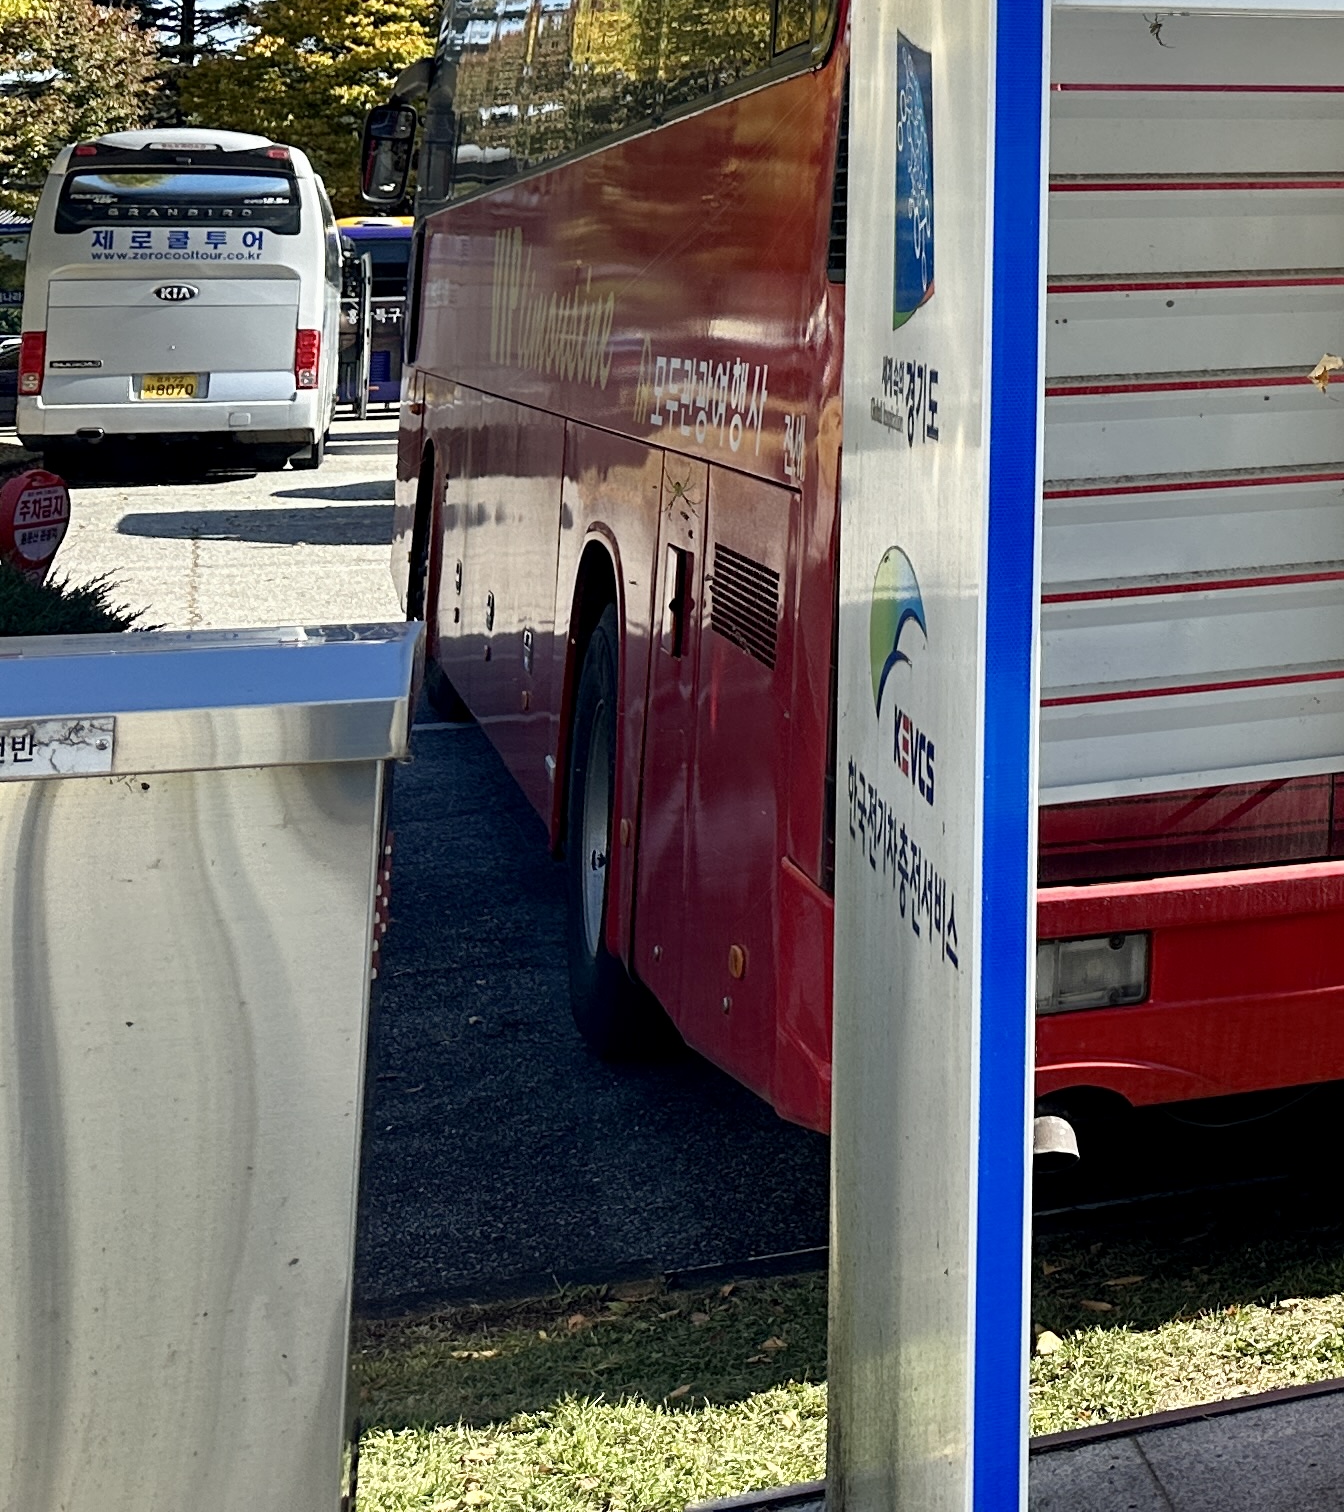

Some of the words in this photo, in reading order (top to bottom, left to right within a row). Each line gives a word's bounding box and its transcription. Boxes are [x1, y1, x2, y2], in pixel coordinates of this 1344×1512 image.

[91, 229, 265, 251] 제로쿨투어
[91, 251, 263, 261] www.zerocooltour.co.kr
[160, 287, 191, 300] KIA
[651, 356, 768, 457] 모두관광여행사
[905, 359, 939, 449] 경기도
[19, 494, 64, 522] 주차금지
[894, 703, 935, 807] KEVCS
[848, 753, 960, 970] 한국전기차충전서비스
